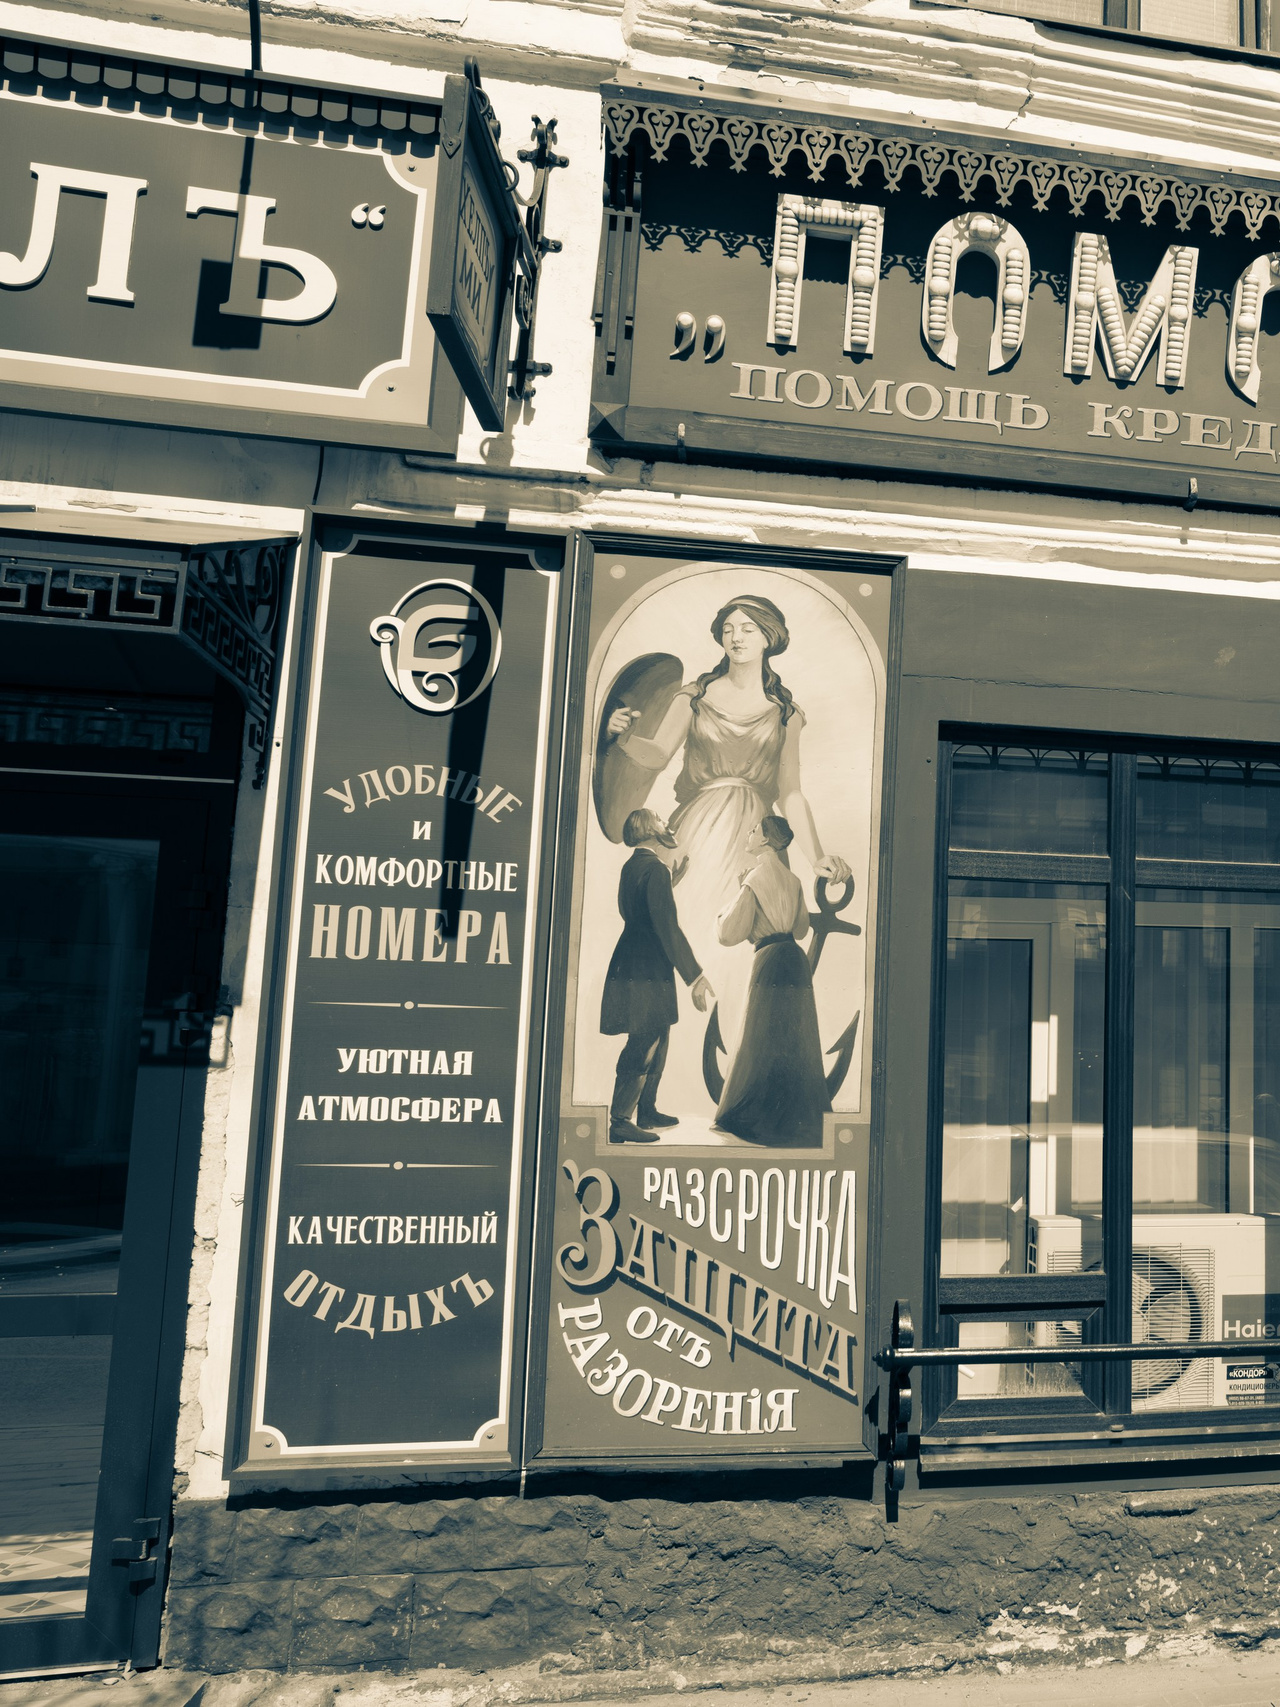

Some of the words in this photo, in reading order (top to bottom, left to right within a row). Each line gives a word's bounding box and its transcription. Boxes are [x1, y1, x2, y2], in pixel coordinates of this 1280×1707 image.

[729, 361, 1051, 436] ПОМОЩЬ
[322, 763, 523, 824] УДОБНЫЕ
[411, 819, 432, 841] И
[314, 852, 520, 893] КОМФОРТНЫЕ
[308, 903, 512, 965] НОМЕРА
[336, 1047, 475, 1077] УЮТНАЯ
[297, 1094, 504, 1124] АТМОСФЕРА
[287, 1210, 499, 1246] КАЧЕСТВЕННЫЙ
[643, 1166, 859, 1315] РАЗСРОЧКА
[283, 1268, 495, 1340] ОТДЫХЪ
[555, 1158, 860, 1406] ЗАЩИТА
[625, 1304, 713, 1369] ОТЪ
